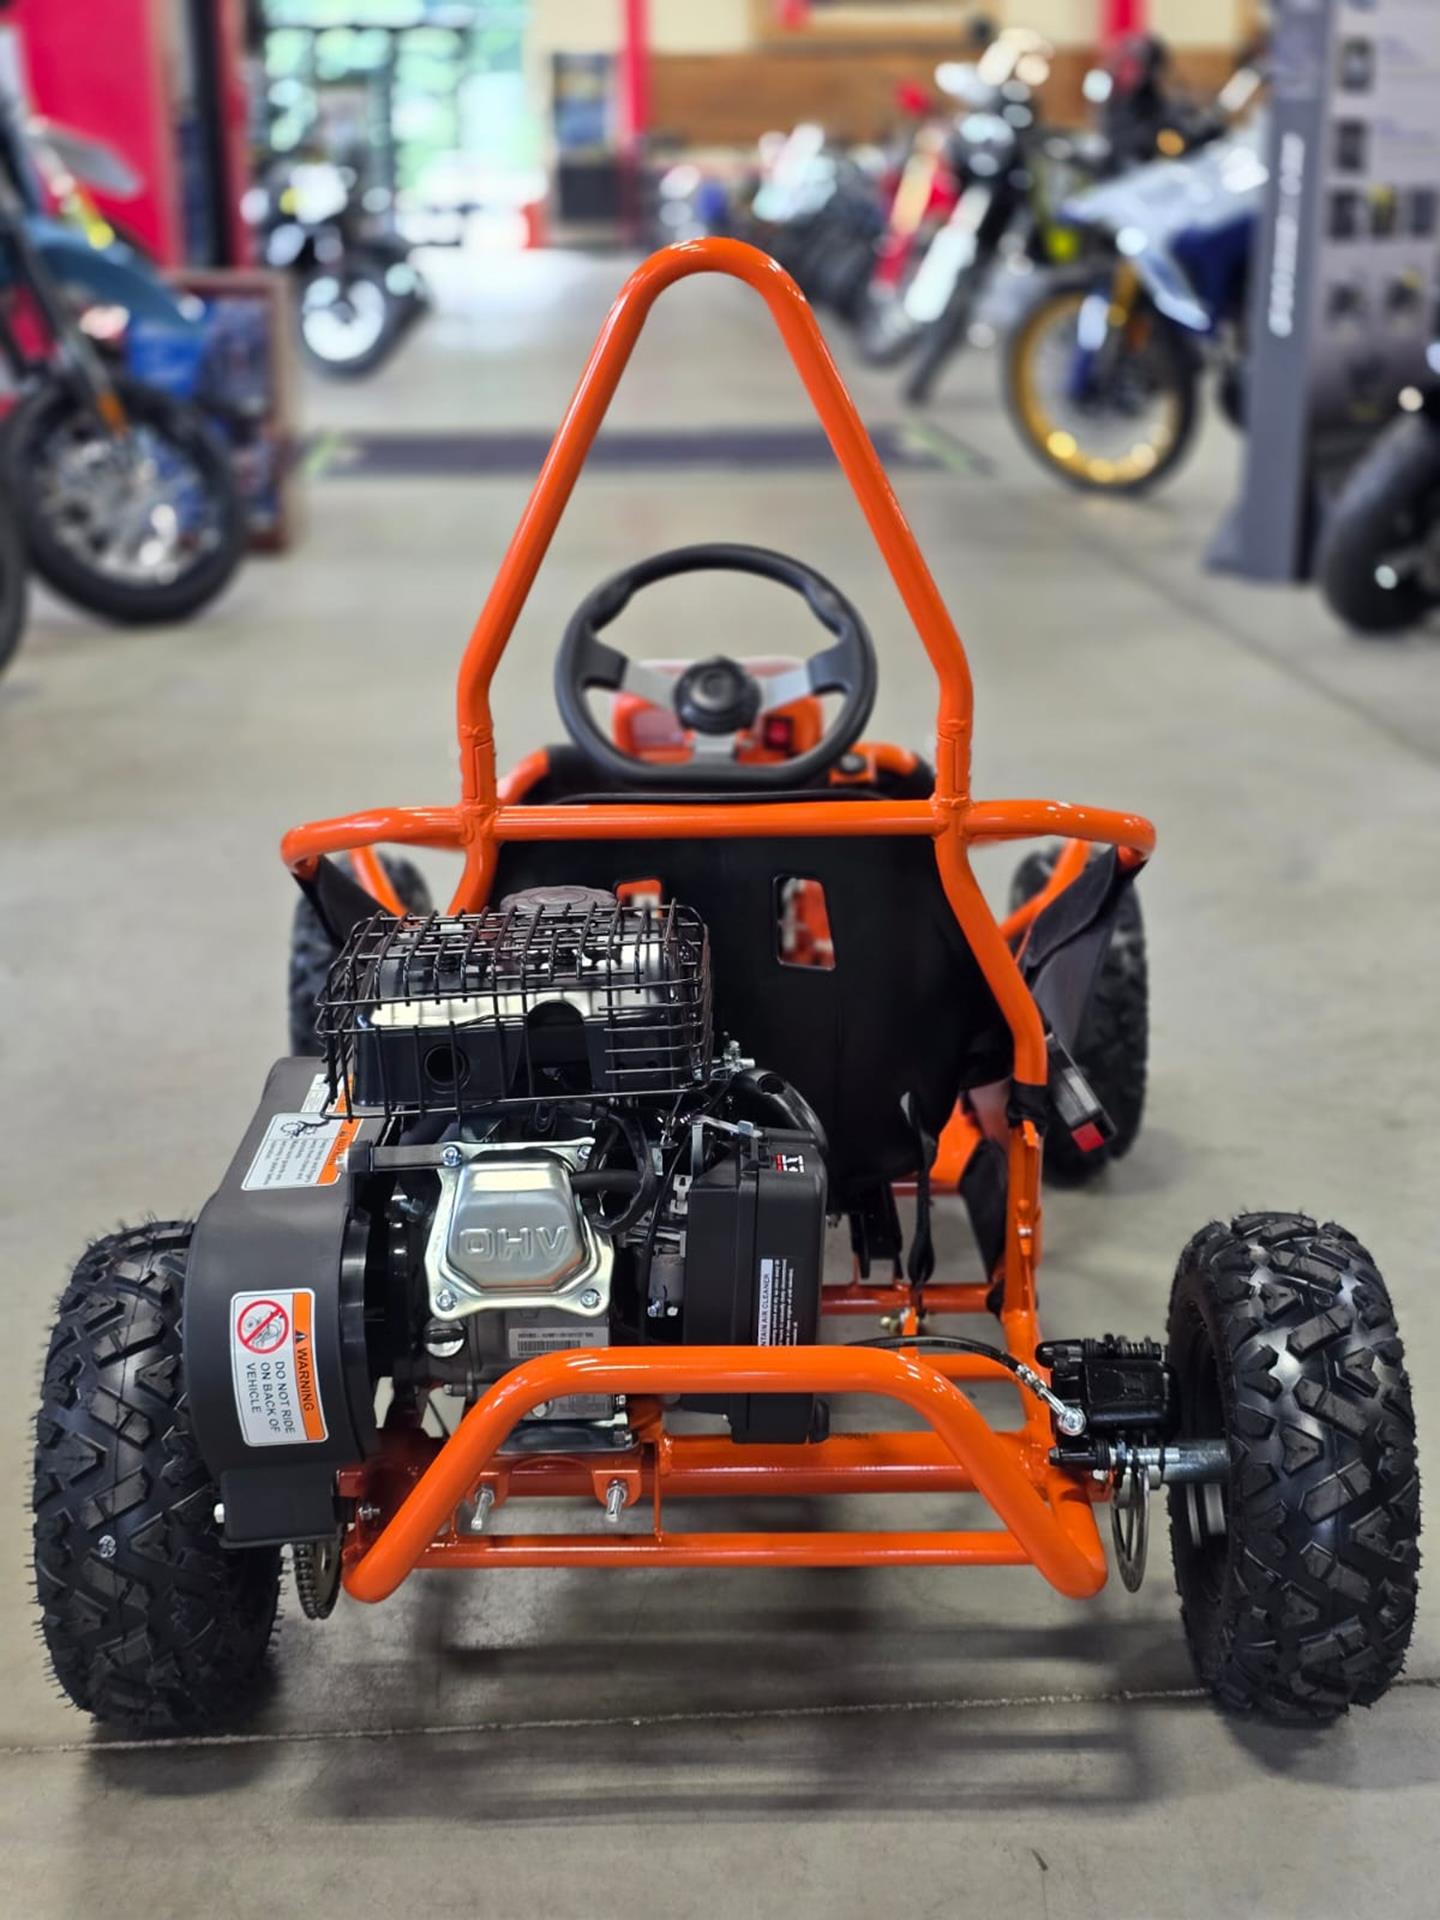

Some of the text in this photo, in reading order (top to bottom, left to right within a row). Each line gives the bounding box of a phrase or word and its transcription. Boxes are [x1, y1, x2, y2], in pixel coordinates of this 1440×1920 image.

[458, 1226, 568, 1261] OHV
[761, 1310, 769, 1323] AIR
[762, 1273, 770, 1309] CLEANER
[247, 1362, 261, 1413] VEHICLE
[261, 1362, 280, 1432] ON BACK OF
[275, 1361, 295, 1433] DO NOT RIDE
[297, 1347, 314, 1411] WARNING
